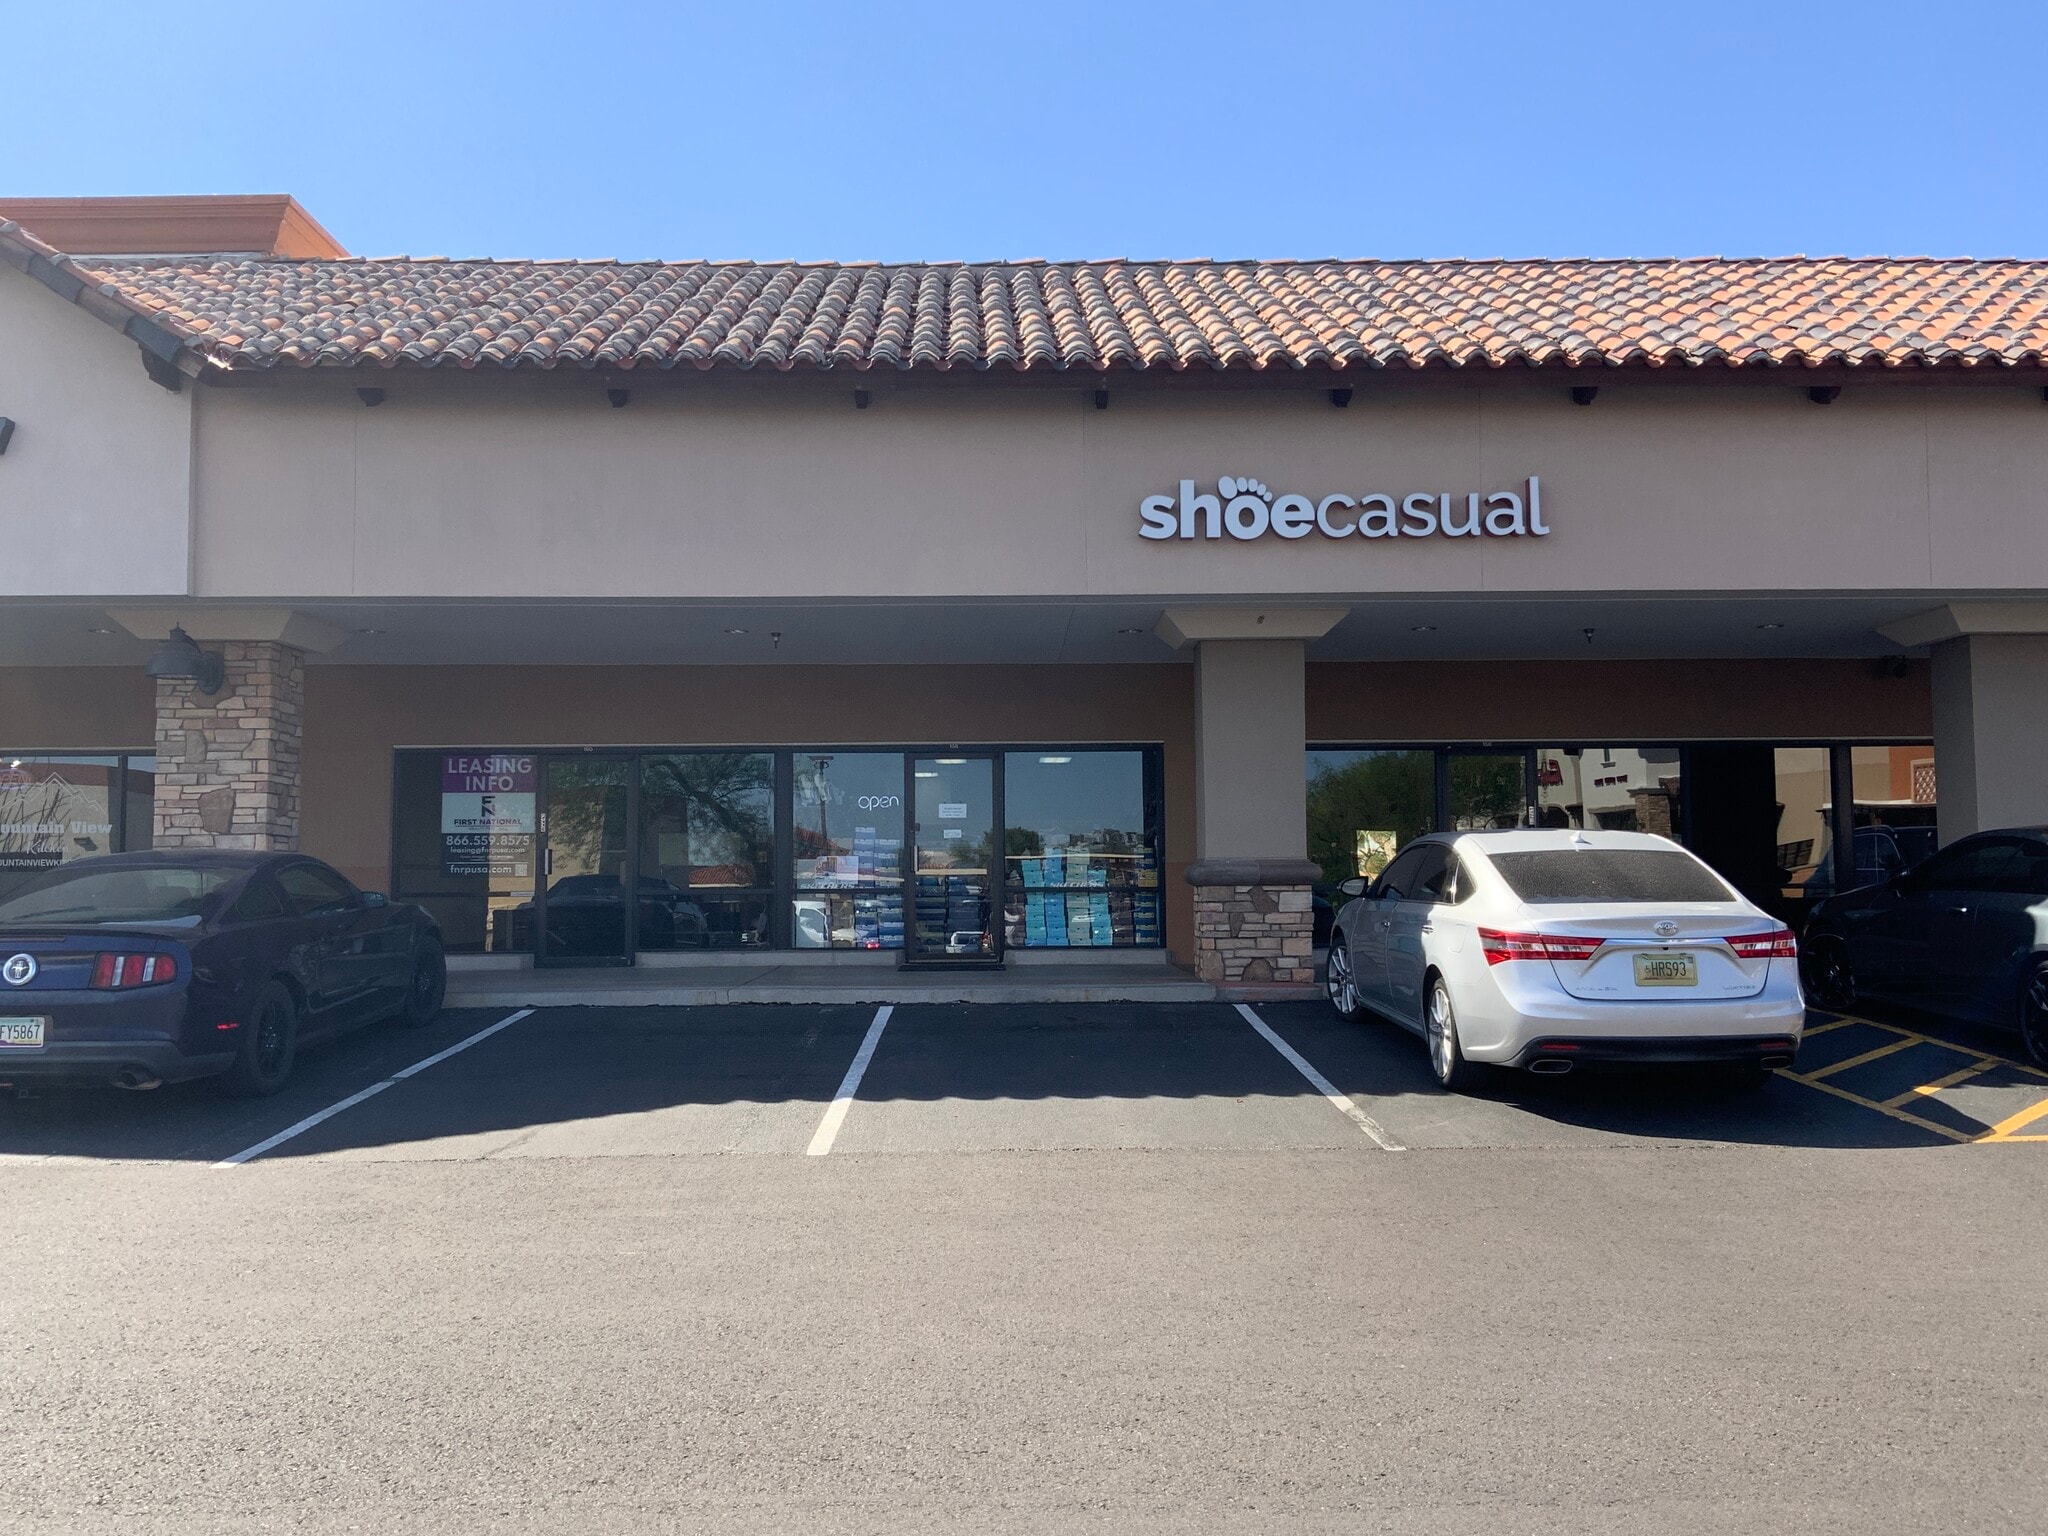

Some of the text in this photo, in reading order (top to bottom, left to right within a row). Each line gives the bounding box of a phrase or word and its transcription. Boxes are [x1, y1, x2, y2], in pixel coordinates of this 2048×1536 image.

[1139, 475, 1550, 541] shoecasual
[448, 758, 532, 774] LEASING
[0, 773, 32, 784] PEN
[466, 775, 514, 791] INFO
[858, 795, 900, 811] open
[0, 821, 112, 834] ountain View
[26, 839, 69, 854] Kitchen
[446, 835, 530, 846] 866.559.8575
[450, 846, 525, 855] leasing@fnrpusa.com
[450, 864, 512, 875] fnrpusa.com
[0, 1024, 41, 1039] FY5867
